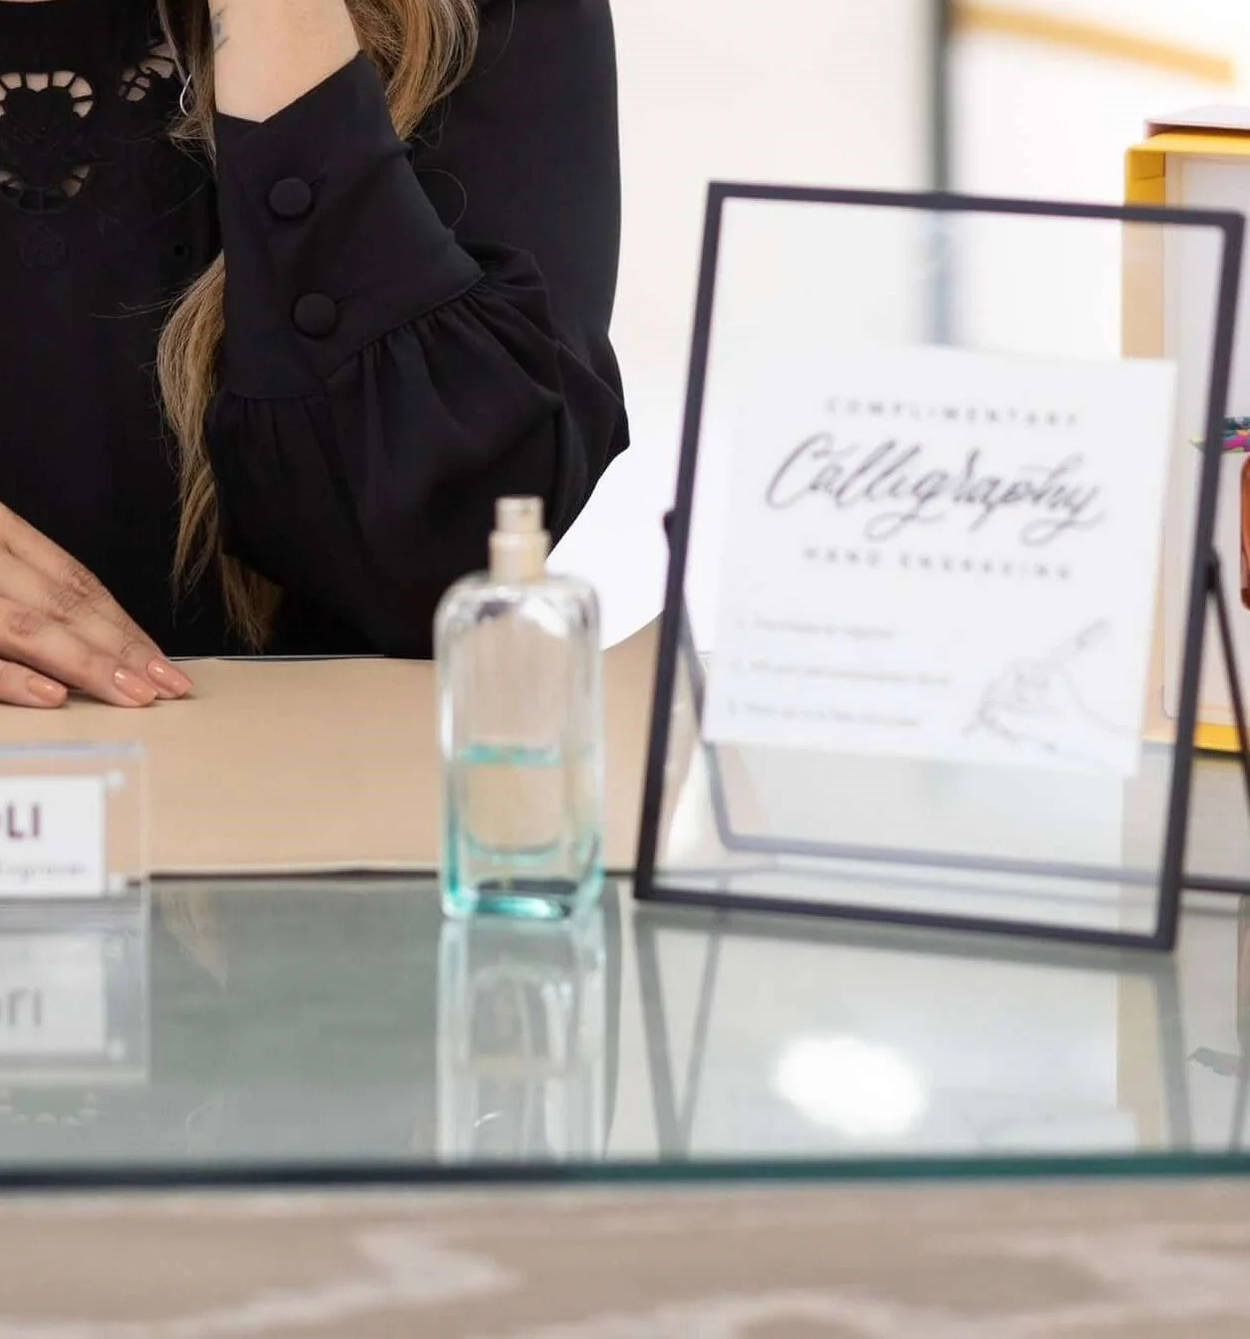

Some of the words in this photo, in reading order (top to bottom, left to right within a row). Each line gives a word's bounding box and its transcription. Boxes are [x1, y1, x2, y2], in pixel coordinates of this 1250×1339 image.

[825, 398, 1079, 425] COMPLIMENTARY
[764, 432, 1106, 545] Calligraphy
[804, 547, 882, 566] HAND
[900, 552, 1072, 578] ENGRAVING
